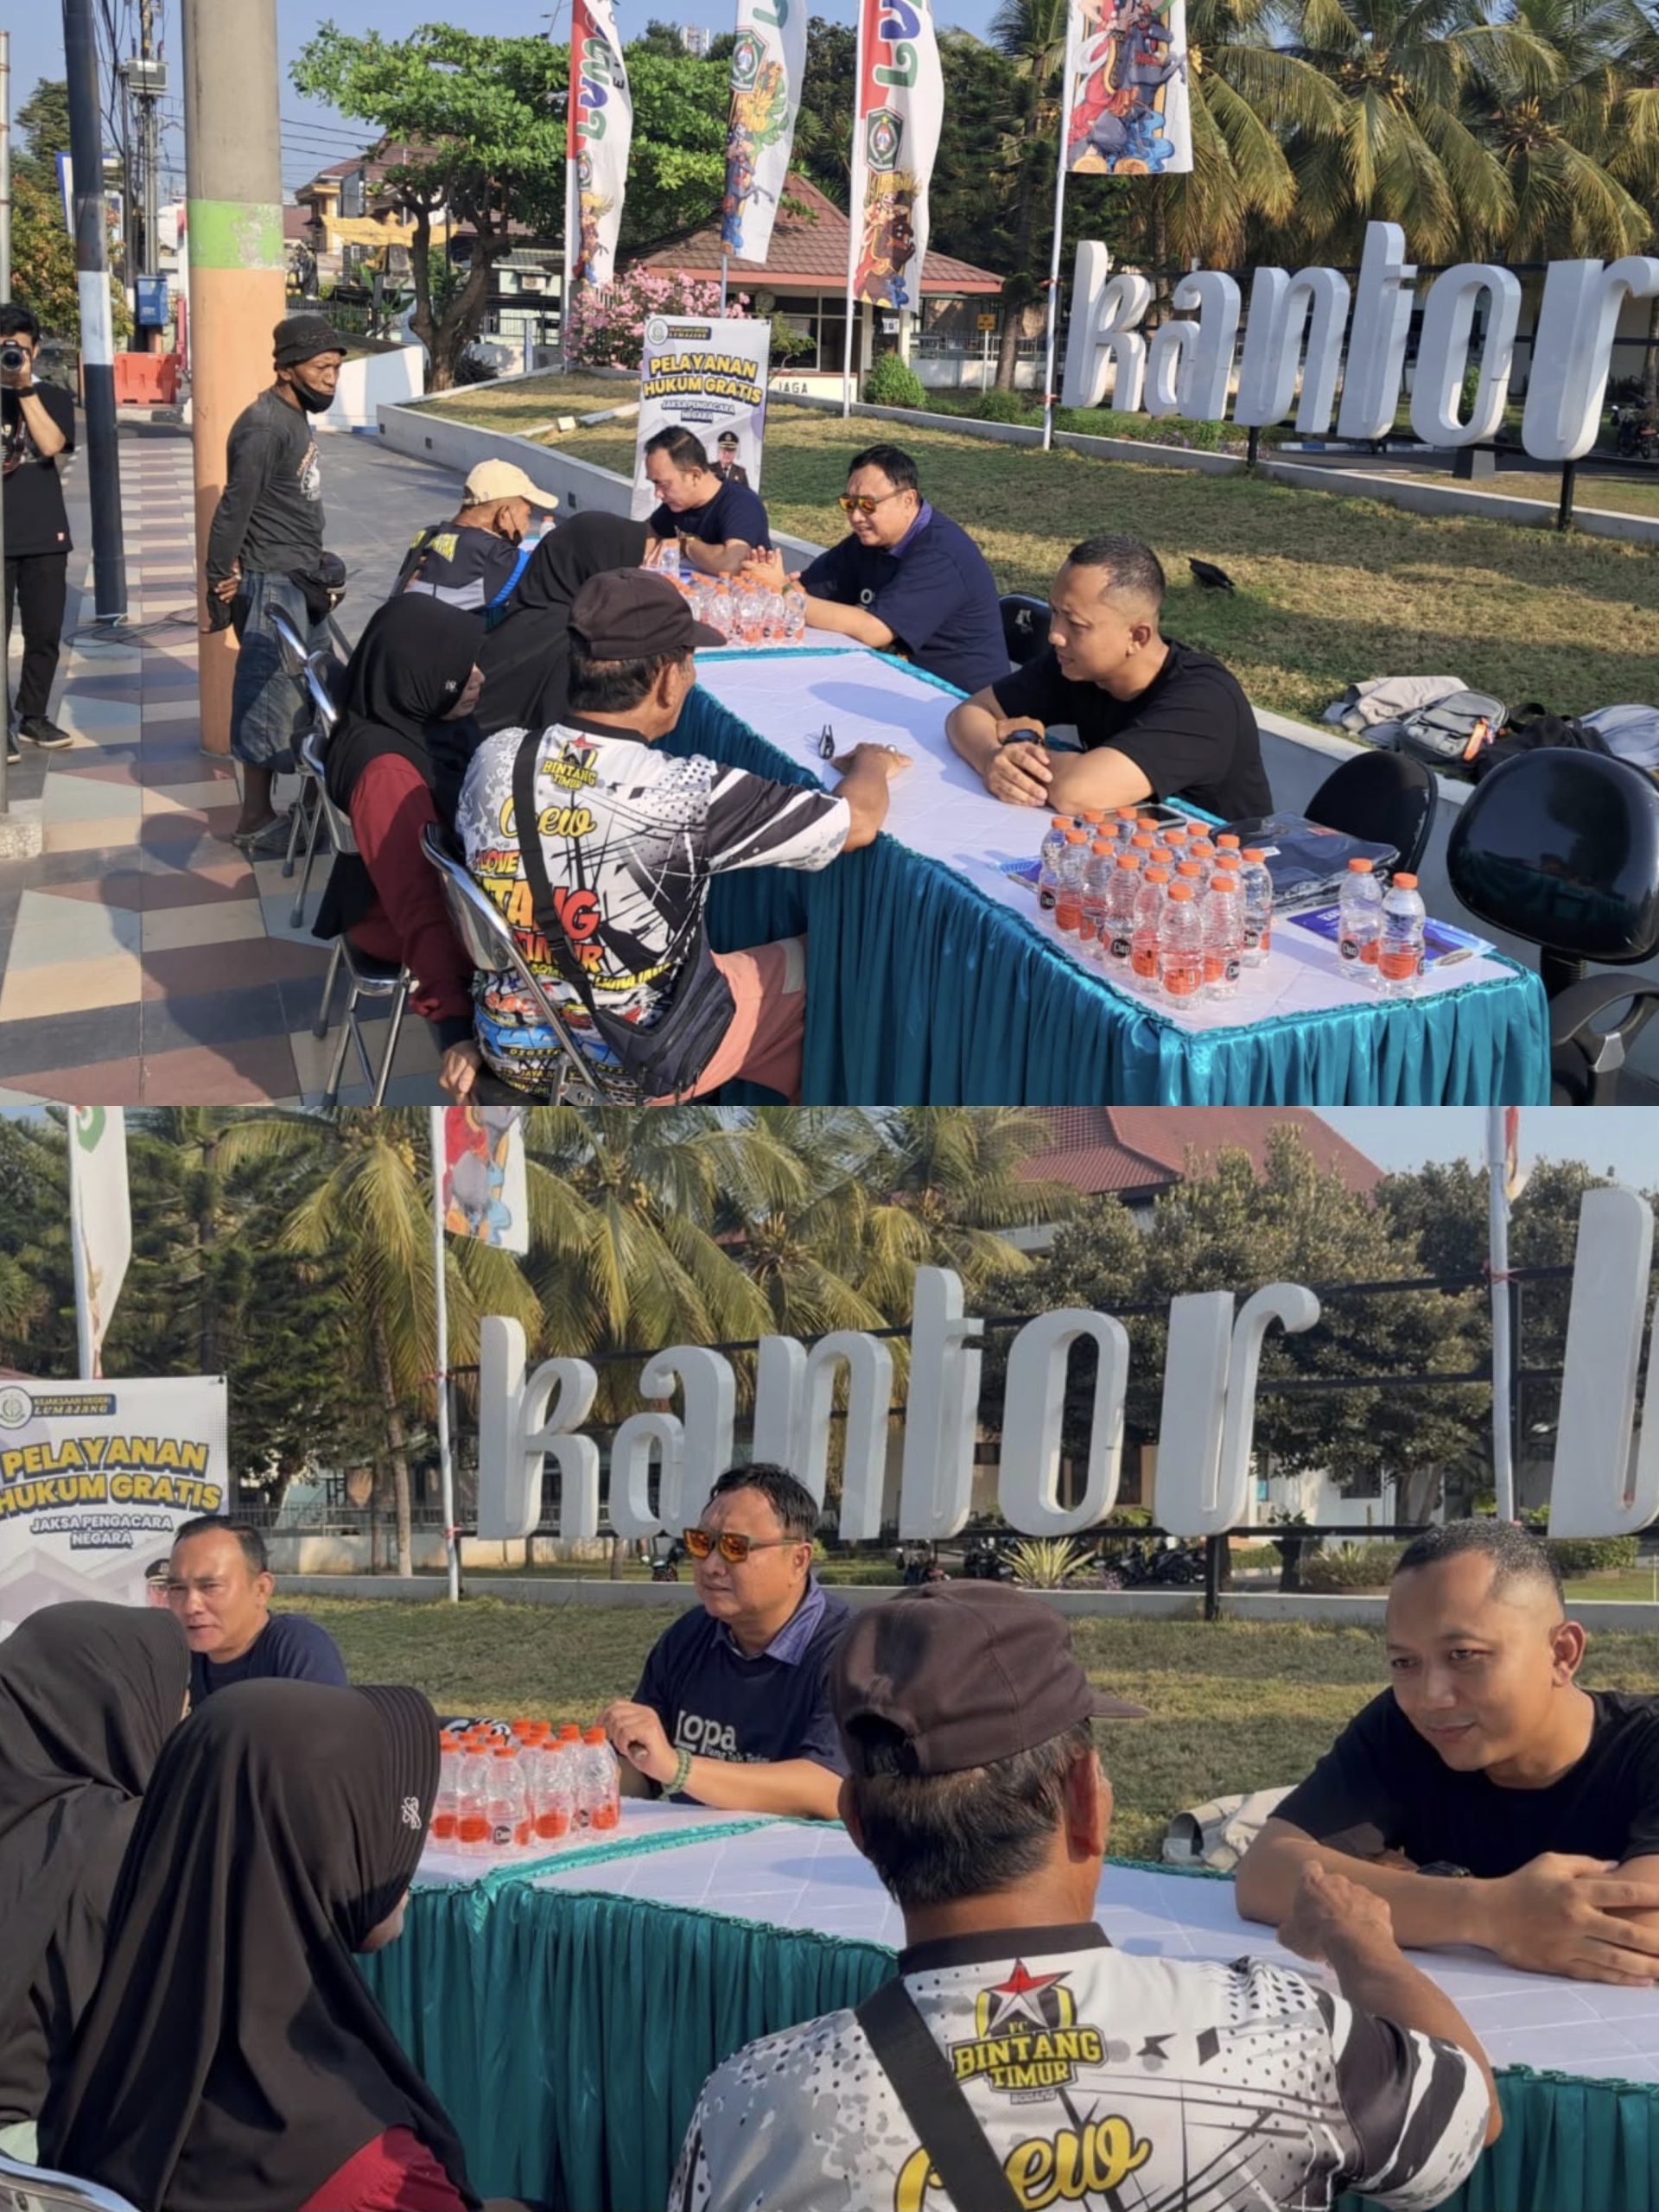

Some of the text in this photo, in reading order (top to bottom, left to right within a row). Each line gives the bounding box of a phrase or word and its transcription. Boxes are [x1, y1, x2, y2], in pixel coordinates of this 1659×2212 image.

[1061, 221, 1659, 461] kantor
[650, 353, 758, 383] PELAYANAN
[643, 376, 763, 406] HUKUM GRATIS
[542, 760, 598, 787] BINTANG
[499, 795, 598, 838] Cew
[476, 1268, 1320, 1541] kantor
[2, 1435, 210, 1483] PELAYANAN
[0, 1473, 223, 1521] HUKUM GRATIS
[31, 1515, 174, 1534] JAKSA PENGACARA
[70, 1532, 134, 1549] NEGARA
[954, 2031, 1103, 2079] BINTANG
[989, 2060, 1070, 2088] TIMUR
